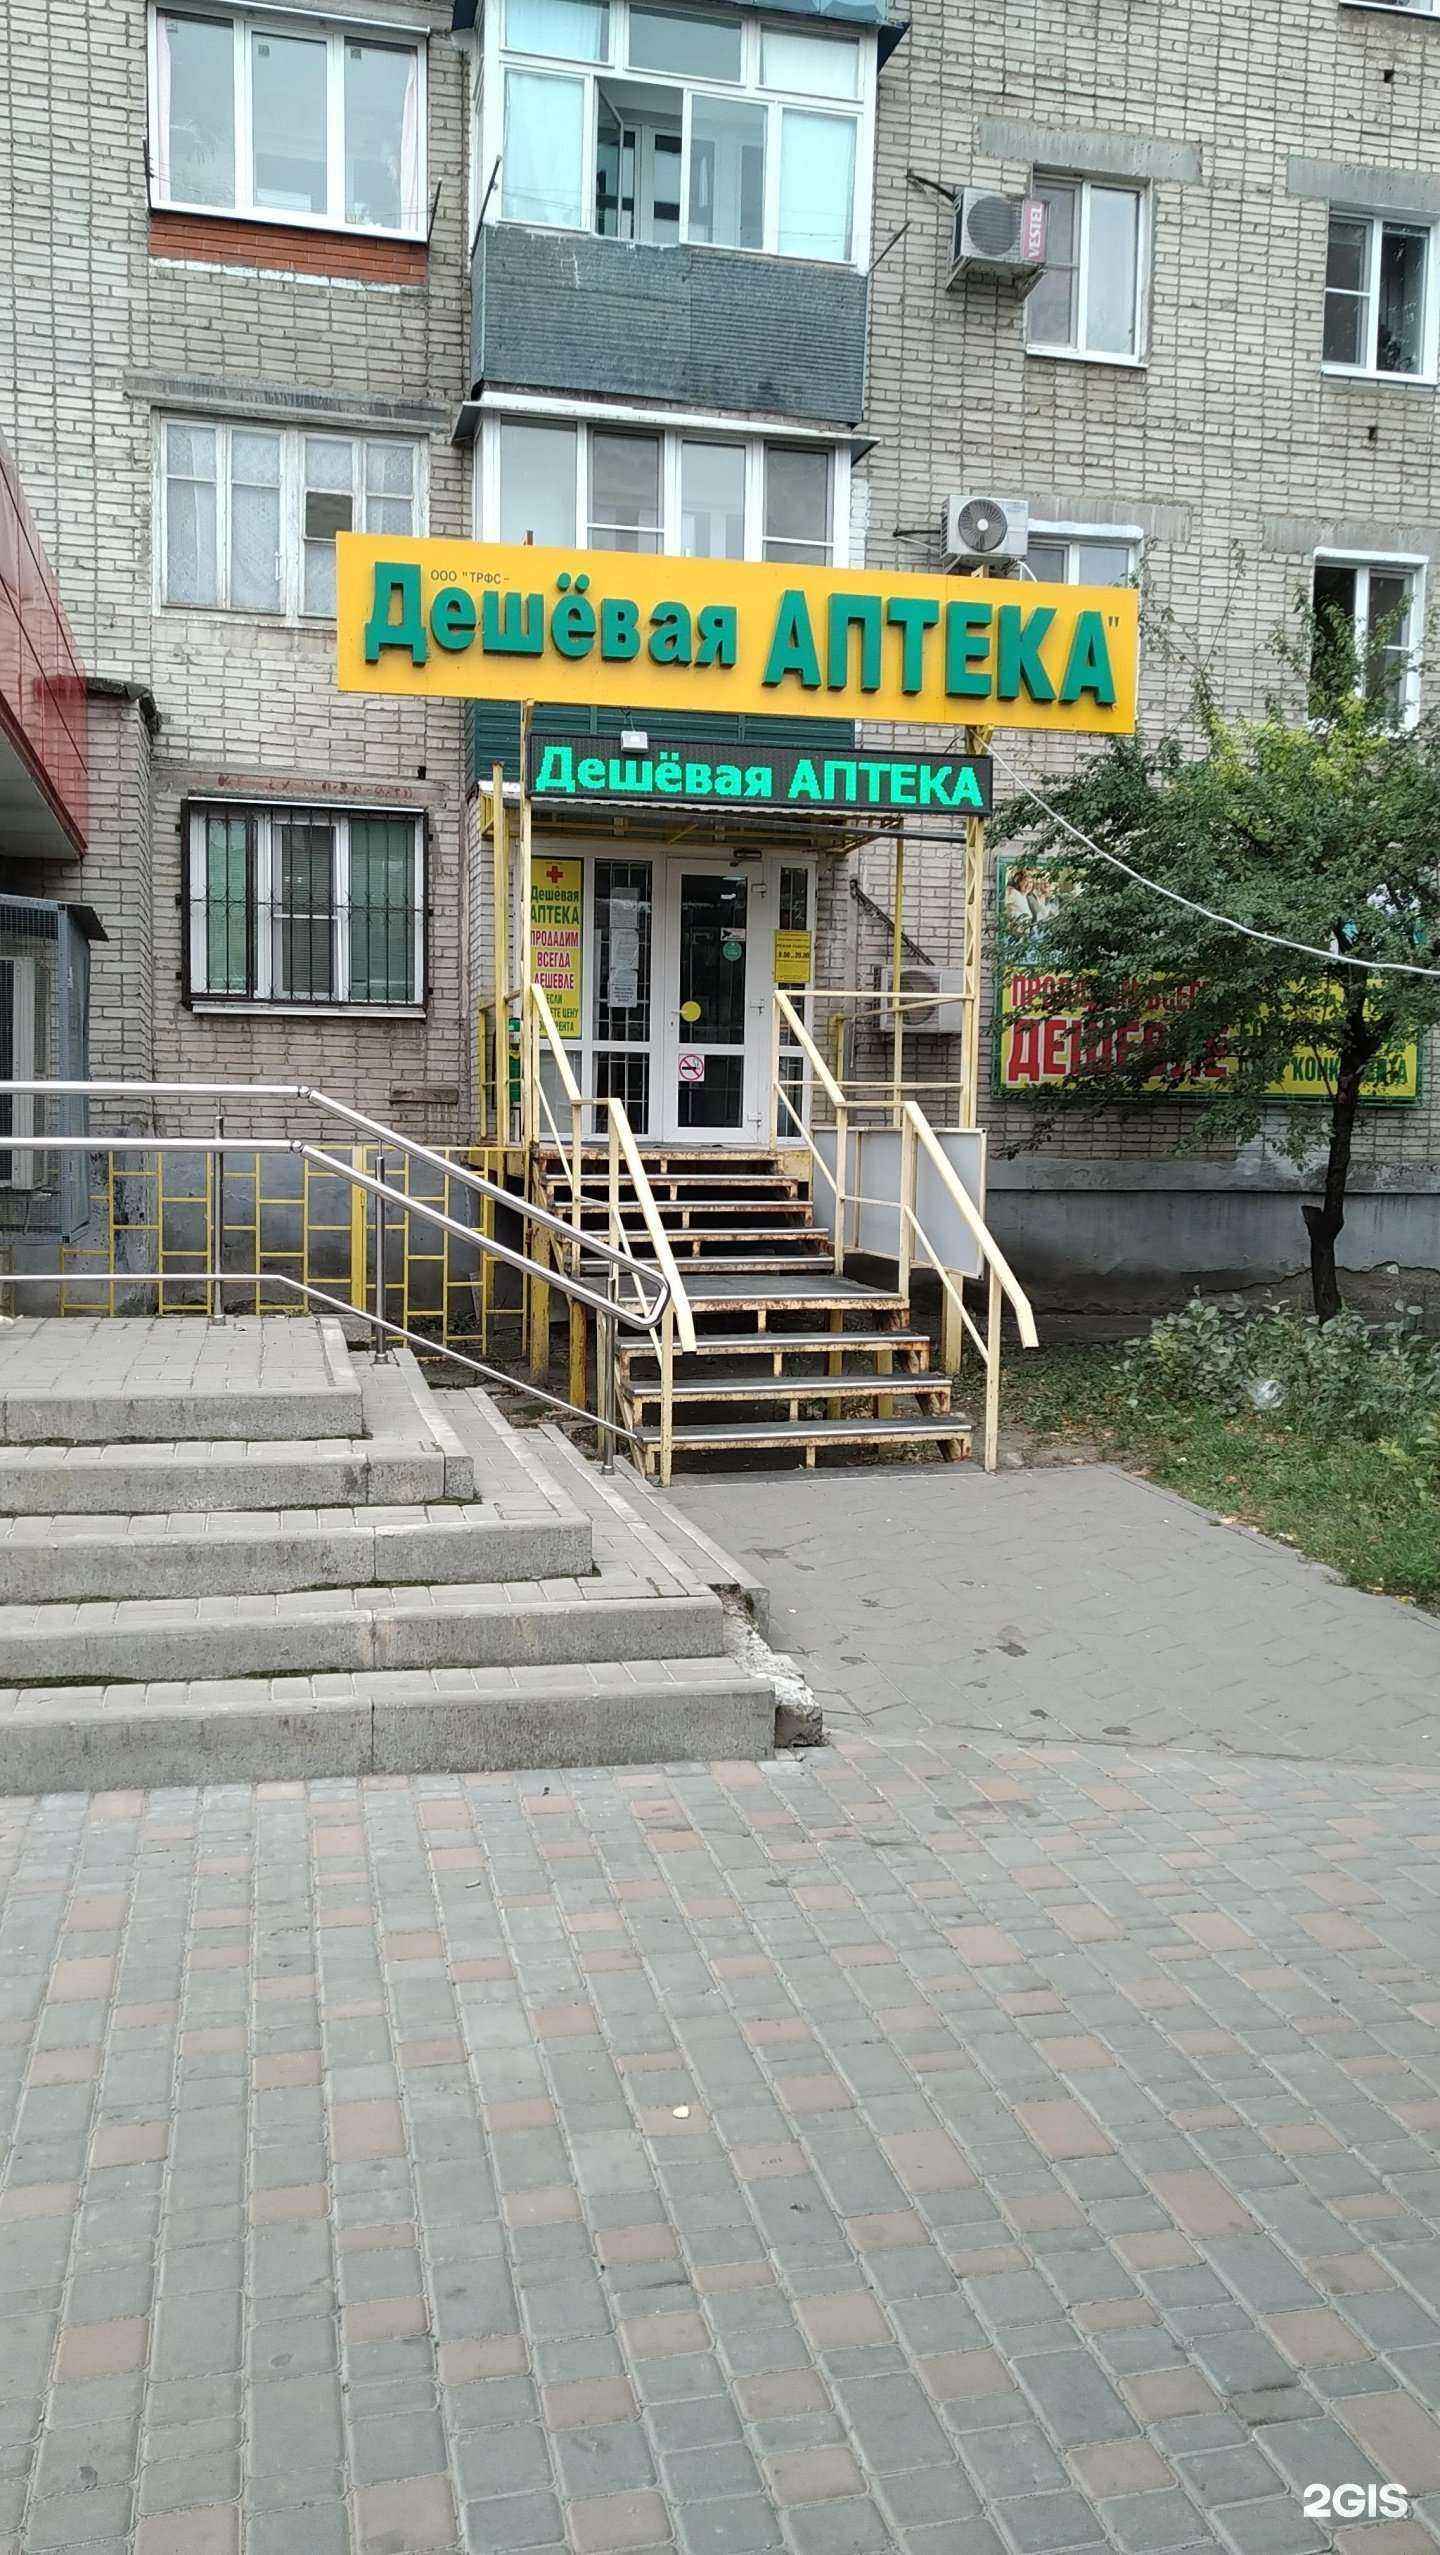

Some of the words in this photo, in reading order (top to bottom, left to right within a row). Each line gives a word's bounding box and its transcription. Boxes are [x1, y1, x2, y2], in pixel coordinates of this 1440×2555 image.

[430, 569, 457, 582] ООО
[365, 561, 738, 668] Дешёвая
[536, 746, 773, 797] Дешёвая
[788, 759, 984, 807] АПТЕКА
[531, 904, 580, 924] АПТЕКА
[531, 930, 579, 947] ПРОДАДИМ
[537, 951, 571, 968] ВСЕГДА
